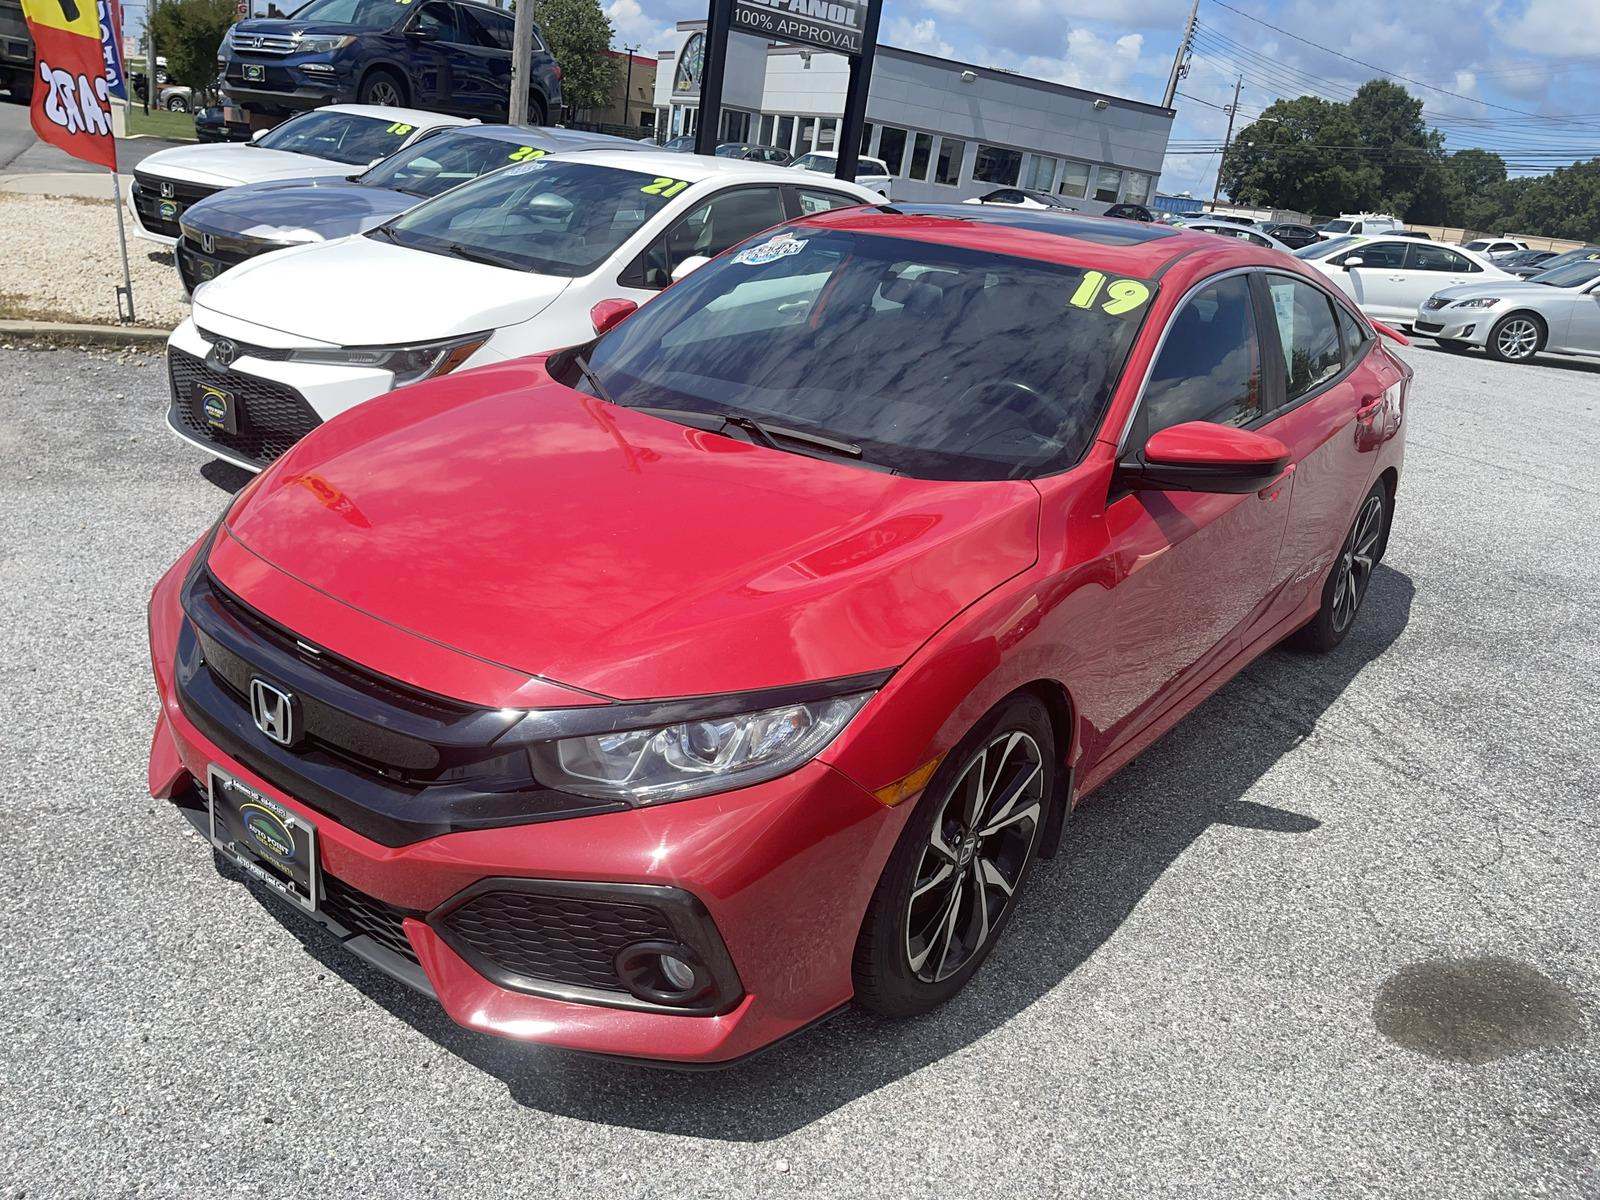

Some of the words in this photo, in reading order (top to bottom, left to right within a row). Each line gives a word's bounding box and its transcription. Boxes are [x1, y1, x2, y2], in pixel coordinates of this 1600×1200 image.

[734, 8, 773, 30] 100%
[777, 19, 859, 50] APPROVAL
[386, 122, 412, 135] 18
[640, 177, 688, 198] 21
[1069, 270, 1150, 316] 19
[249, 823, 267, 839] AUTO
[267, 836, 289, 855] POINT
